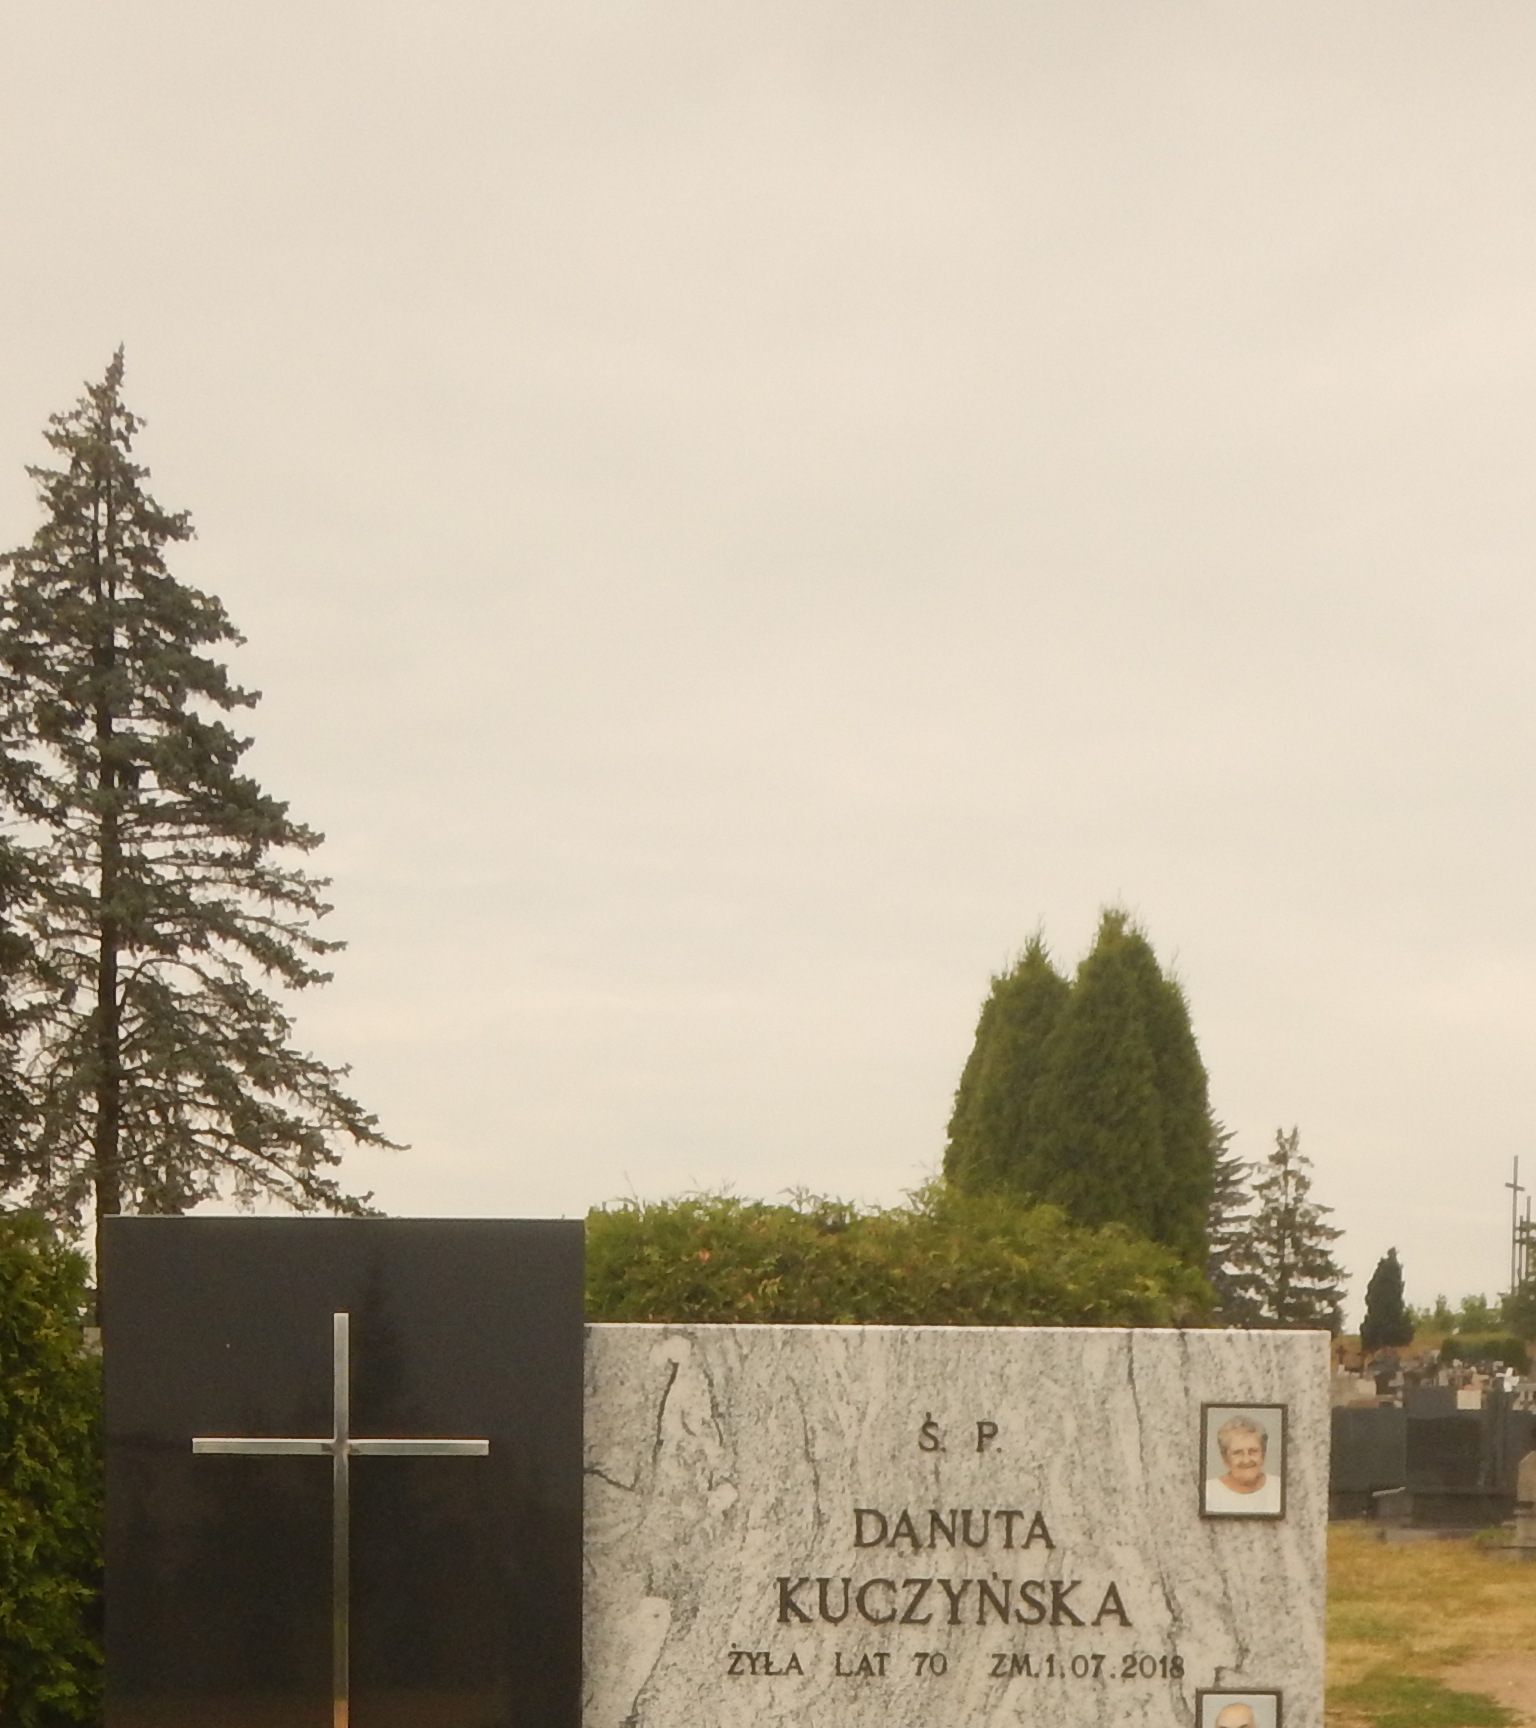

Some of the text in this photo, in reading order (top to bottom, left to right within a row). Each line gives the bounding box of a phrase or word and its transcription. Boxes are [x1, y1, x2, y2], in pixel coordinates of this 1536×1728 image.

[854, 1508, 1056, 1549] DANUTA
[776, 1571, 1133, 1627] KUCZYŃSKA
[727, 1642, 805, 1677] ŻYŁA
[835, 1652, 891, 1677] LAT
[914, 1652, 948, 1678] 70
